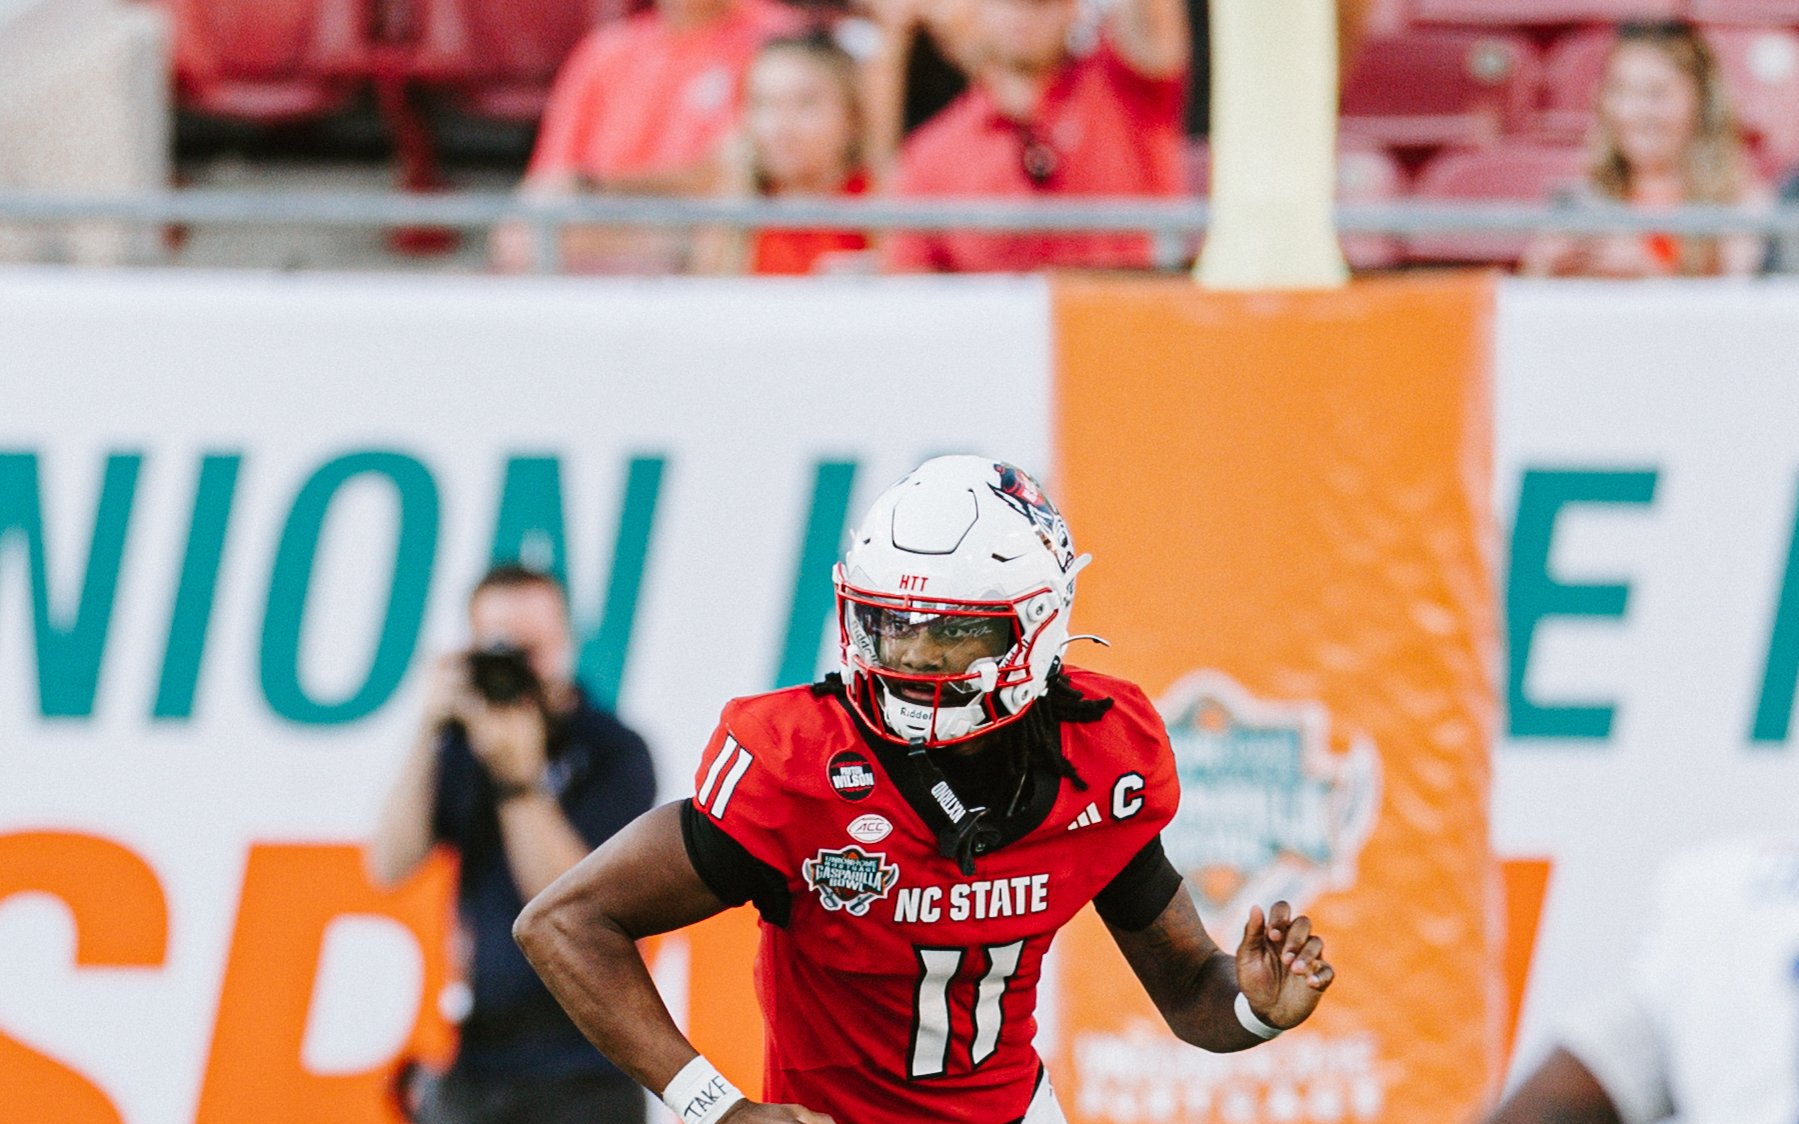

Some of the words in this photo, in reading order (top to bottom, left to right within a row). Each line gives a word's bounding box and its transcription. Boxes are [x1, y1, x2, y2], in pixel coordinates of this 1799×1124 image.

[899, 574, 929, 592] HTT
[899, 706, 934, 722] Riddel
[697, 736, 753, 820] 11
[832, 773, 875, 789] WILSON
[1111, 772, 1146, 823] C
[856, 822, 885, 834] ACC
[815, 864, 883, 891] GASPARILLA
[829, 878, 865, 893] BOWL
[894, 886, 943, 923] NC
[948, 873, 1050, 921] STATE
[909, 940, 1025, 1079] 11
